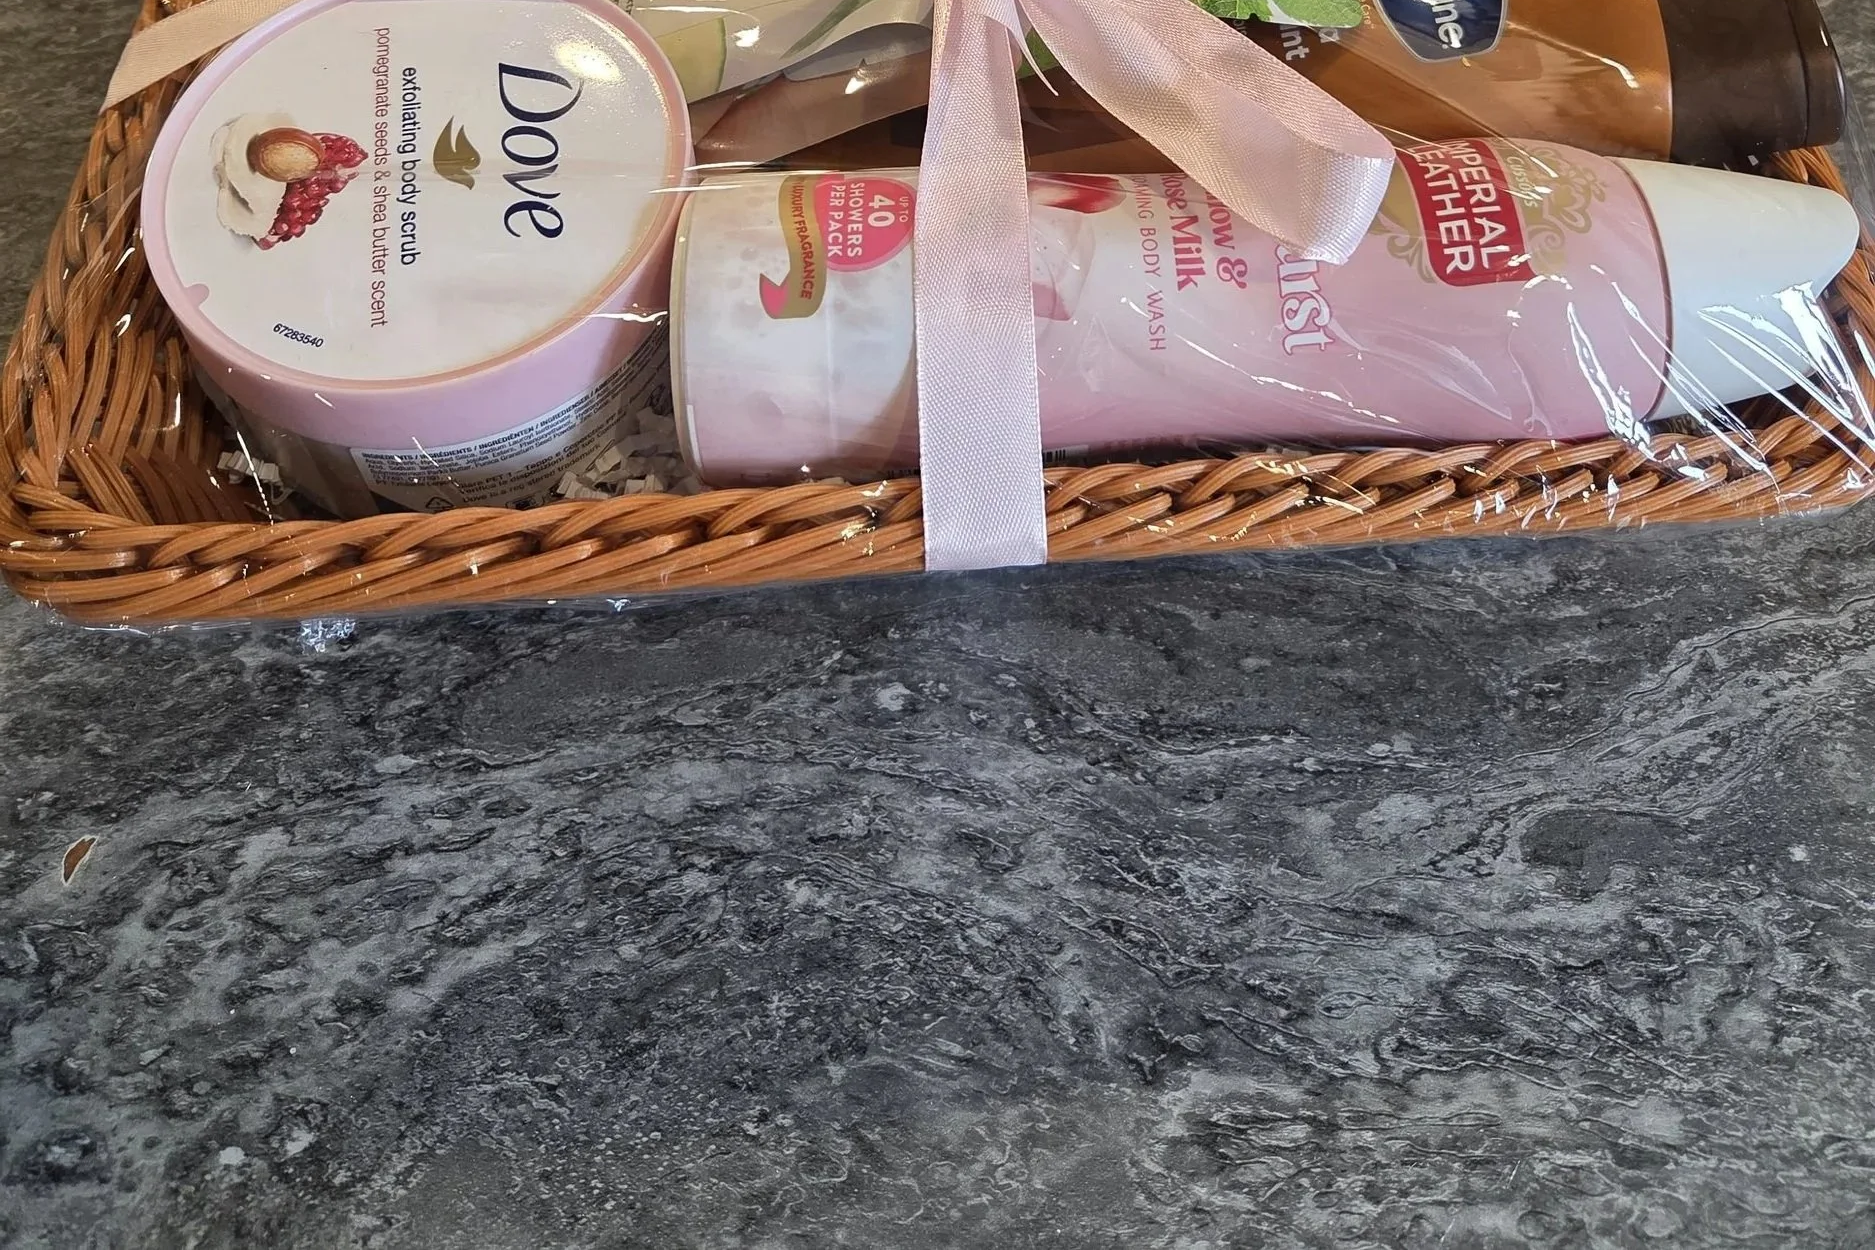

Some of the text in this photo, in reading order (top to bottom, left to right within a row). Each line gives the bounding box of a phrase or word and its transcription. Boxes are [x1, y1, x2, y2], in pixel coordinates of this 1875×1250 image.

[370, 27, 391, 328] pomegranate seeds & shea butter scent
[397, 66, 422, 267] exfoliating body scrub
[498, 62, 585, 239] Dove
[827, 185, 846, 258] PER PACK
[847, 182, 865, 257] SHOWERS
[867, 194, 896, 228] 40
[899, 196, 910, 223] UP TO
[1440, 140, 1511, 270] IMPERIAL
[794, 219, 816, 300] FRAGRANCE
[1139, 227, 1161, 277] BODY
[1169, 214, 1207, 291] Milk
[1216, 256, 1248, 289] &
[272, 322, 325, 349] 67283540
[1146, 290, 1167, 351] WASH
